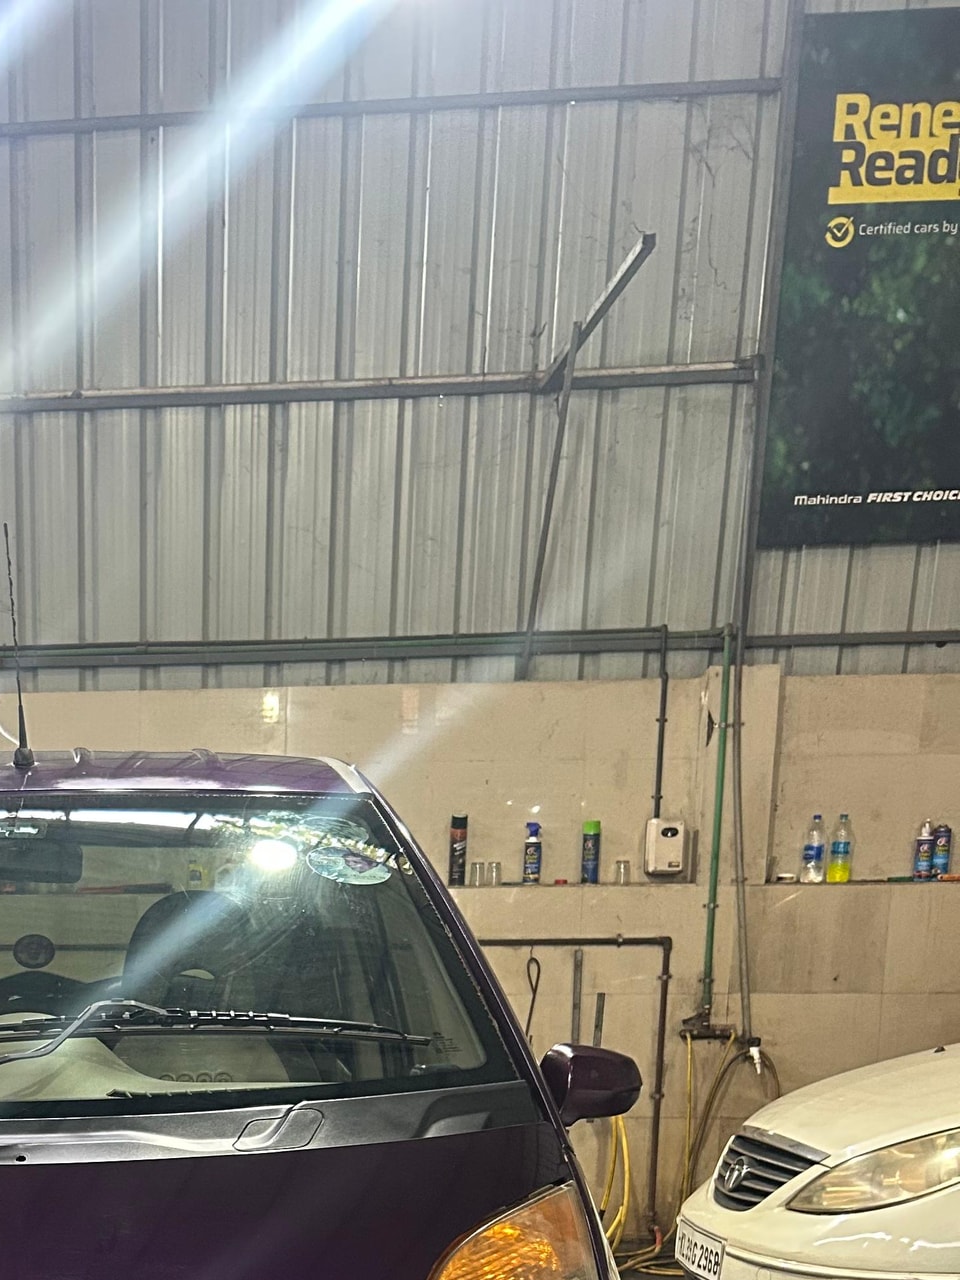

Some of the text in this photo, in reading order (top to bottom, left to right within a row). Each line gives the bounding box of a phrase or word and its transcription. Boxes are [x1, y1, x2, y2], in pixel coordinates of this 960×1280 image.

[833, 93, 960, 142] Rene
[837, 134, 960, 196] Read
[858, 220, 959, 236] Certified cars by
[794, 493, 863, 506] Mahindra
[866, 491, 913, 504] FIRST
[697, 1243, 721, 1276] 2968
